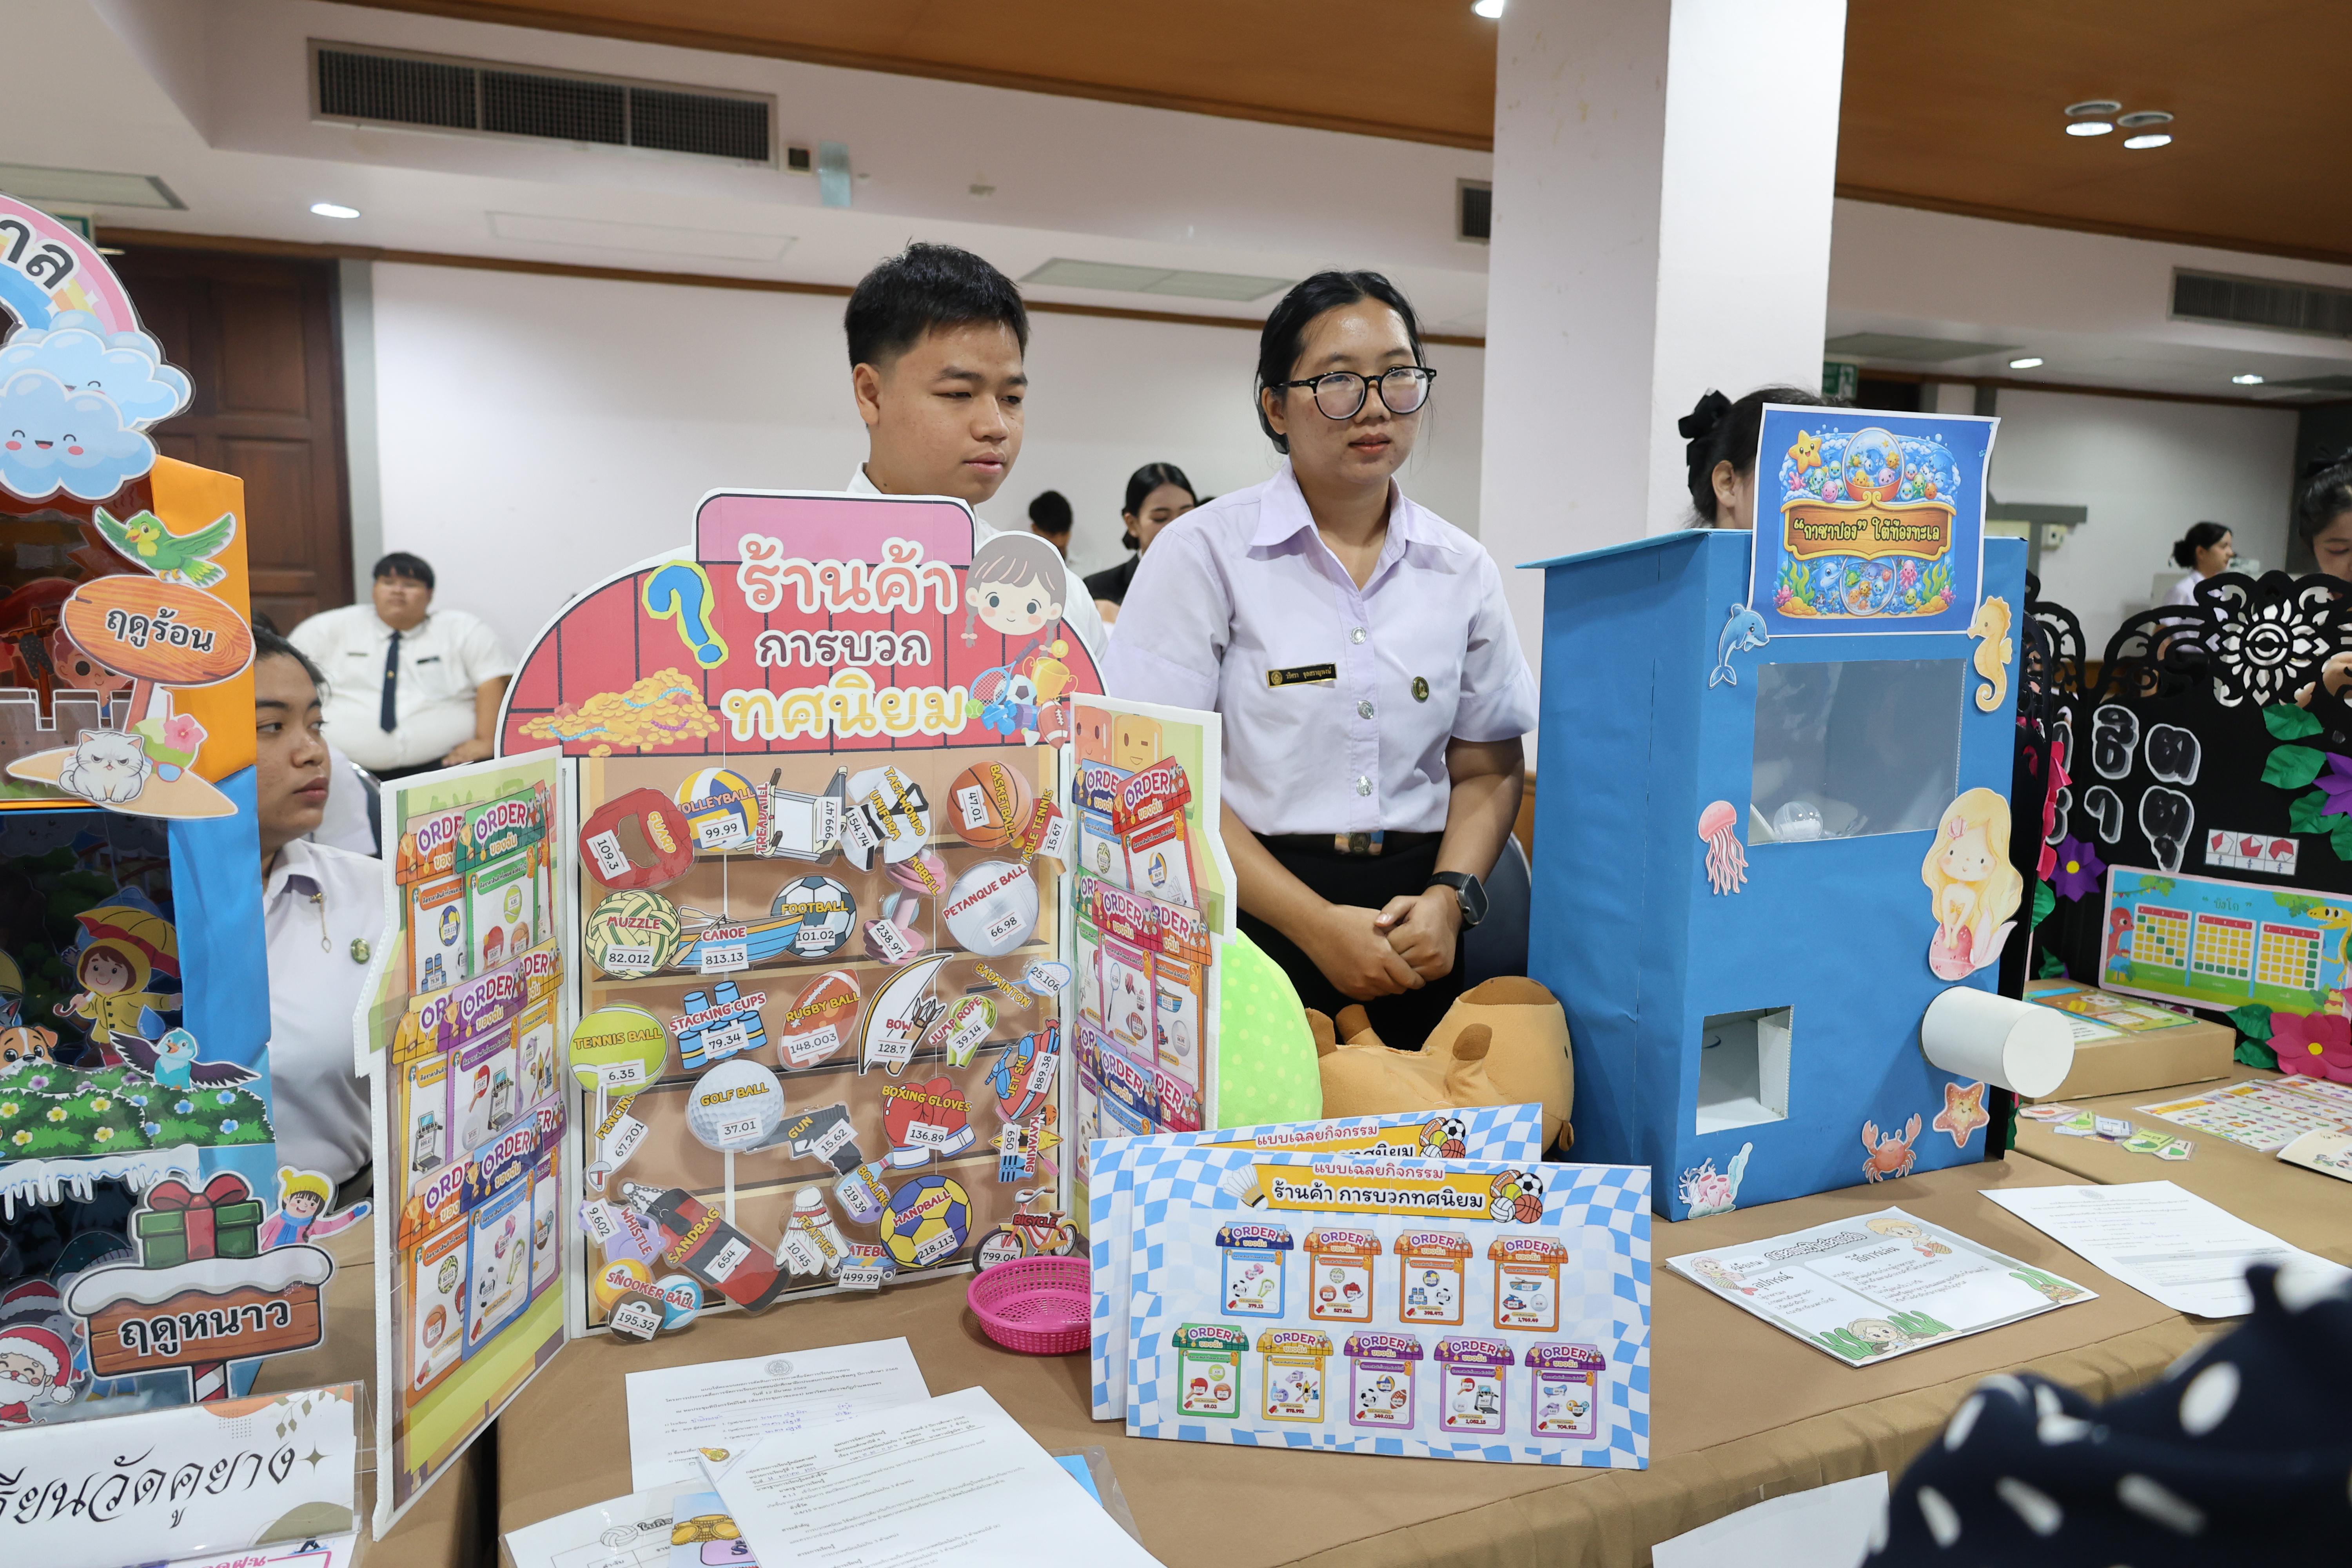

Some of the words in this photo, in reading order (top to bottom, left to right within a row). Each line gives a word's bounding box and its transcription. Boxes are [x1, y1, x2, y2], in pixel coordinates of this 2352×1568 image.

[1872, 518, 1940, 541] ใต้ท้องทะเล
[739, 537, 956, 612] ร้านค้า
[106, 607, 216, 652] ฤดูร้อน
[757, 633, 929, 666] การบวก
[726, 671, 965, 735] ทศนิยม
[990, 764, 1017, 837] BASKETBALL
[1125, 770, 1170, 807] ORDER
[884, 766, 926, 837] TAEKWONDO
[968, 792, 982, 822] 47.01
[1138, 799, 1163, 819] ของฉัน
[476, 804, 526, 839] ORDER
[825, 800, 835, 839] 999.47
[869, 789, 901, 841] UNIFORM
[647, 811, 677, 853] GUARD
[706, 823, 738, 838] 99.99
[847, 813, 869, 847] 154.74
[1019, 832, 1039, 866] TABLE
[1032, 789, 1053, 829] TENNIS
[1047, 824, 1062, 851] 15.67
[490, 832, 517, 854] ของฉัน
[596, 839, 619, 871] 109.3
[943, 882, 1000, 920] PETANQUE
[998, 865, 1027, 891] BALL
[781, 901, 849, 914] FOOTBALL
[1104, 893, 1142, 928] ORDER
[606, 916, 662, 929] MUZZLE
[702, 927, 746, 941] CANOE
[991, 916, 1017, 937] 66.98
[1113, 919, 1134, 938] ของฉัน
[797, 931, 835, 941] 101.02
[877, 924, 904, 955] 238.97
[609, 953, 650, 964] 82.012
[706, 952, 744, 964] 813.13
[975, 962, 1031, 1008] BADMINTON
[1031, 967, 1060, 991] 25.106
[463, 975, 512, 1016] ORDER
[785, 1001, 828, 1023] RUGBY
[831, 991, 860, 1008] BALL
[477, 1007, 503, 1030] ของฉัน
[669, 1004, 732, 1032] STACKING
[733, 994, 765, 1012] CUPS
[886, 1019, 912, 1031] BOW
[931, 1018, 956, 1045] JUMP
[956, 996, 982, 1021] ROPE
[574, 1032, 624, 1050] TENNIS
[627, 1028, 663, 1043] BALL
[709, 1033, 742, 1049] 79.34
[790, 1033, 837, 1054] 148.003
[956, 1024, 982, 1049] 39.14
[878, 1044, 906, 1054] 128.7
[609, 1069, 635, 1081] 6.35
[1007, 1075, 1021, 1097] JET
[1014, 1054, 1028, 1074] SKI
[1034, 1055, 1051, 1090] 889.38
[1102, 1053, 1143, 1093] ORDER
[701, 1089, 734, 1107] GOLF
[737, 1083, 769, 1099] BALL
[882, 1085, 926, 1103] BOXING
[928, 1095, 971, 1112] GLOVES
[1111, 1081, 1133, 1103] ของฉัน
[595, 1094, 637, 1140] FENCING
[724, 1121, 756, 1135] 37.01
[788, 1116, 813, 1139] GUN
[615, 1122, 644, 1158] 67.201
[821, 1129, 848, 1152] 15.62
[910, 1129, 944, 1143] 136.89
[1029, 1116, 1042, 1173] KAYAKING
[1258, 1125, 1377, 1145] แบบเฉลยกิจกรรม
[482, 1133, 530, 1175] ORDER
[495, 1162, 521, 1187] ของฉัน
[1314, 1162, 1443, 1179] แบบเฉลยกิจกรรม
[857, 1164, 889, 1207] BOWLING
[1274, 1180, 1332, 1202] ร้านค้า
[1339, 1186, 1483, 1207] การบวกทศนิยม
[843, 1185, 867, 1214] 219.39
[892, 1191, 951, 1228] HANDBALL
[589, 1207, 611, 1237] 9.602
[621, 1207, 653, 1256] WHISTLE
[1013, 1214, 1058, 1229] BICYCLE
[1233, 1226, 1276, 1239] ORDER
[667, 1207, 720, 1265] SANDBAG
[797, 1214, 838, 1259] FEATHER
[918, 1234, 955, 1259] 218.113
[1243, 1239, 1267, 1247] ของฉัน
[1321, 1232, 1364, 1245] ORDER
[1412, 1235, 1455, 1247] ORDER
[1505, 1240, 1550, 1253] ORDER
[717, 1250, 736, 1269] 654
[787, 1242, 811, 1268] 10.45
[1845, 1247, 1900, 1263] วิธีการเล่น
[844, 1273, 878, 1282] 499.99
[1752, 1271, 1794, 1290] อุปกรณ์
[606, 1272, 665, 1299] SNOOKER
[666, 1292, 694, 1310] BALL
[120, 1301, 290, 1354] ฤดูหนาว
[618, 1313, 654, 1331] 195.32
[1189, 1328, 1232, 1341] ORDER
[1199, 1340, 1222, 1348] ของฉัน
[1274, 1332, 1316, 1347] ORDER
[1361, 1336, 1405, 1349] ORDER
[1283, 1345, 1306, 1354] ของฉัน
[1372, 1348, 1396, 1357] ของฉัน
[1452, 1341, 1496, 1355] ORDER
[1462, 1354, 1487, 1362] ของฉัน
[1543, 1347, 1587, 1360] ORDER
